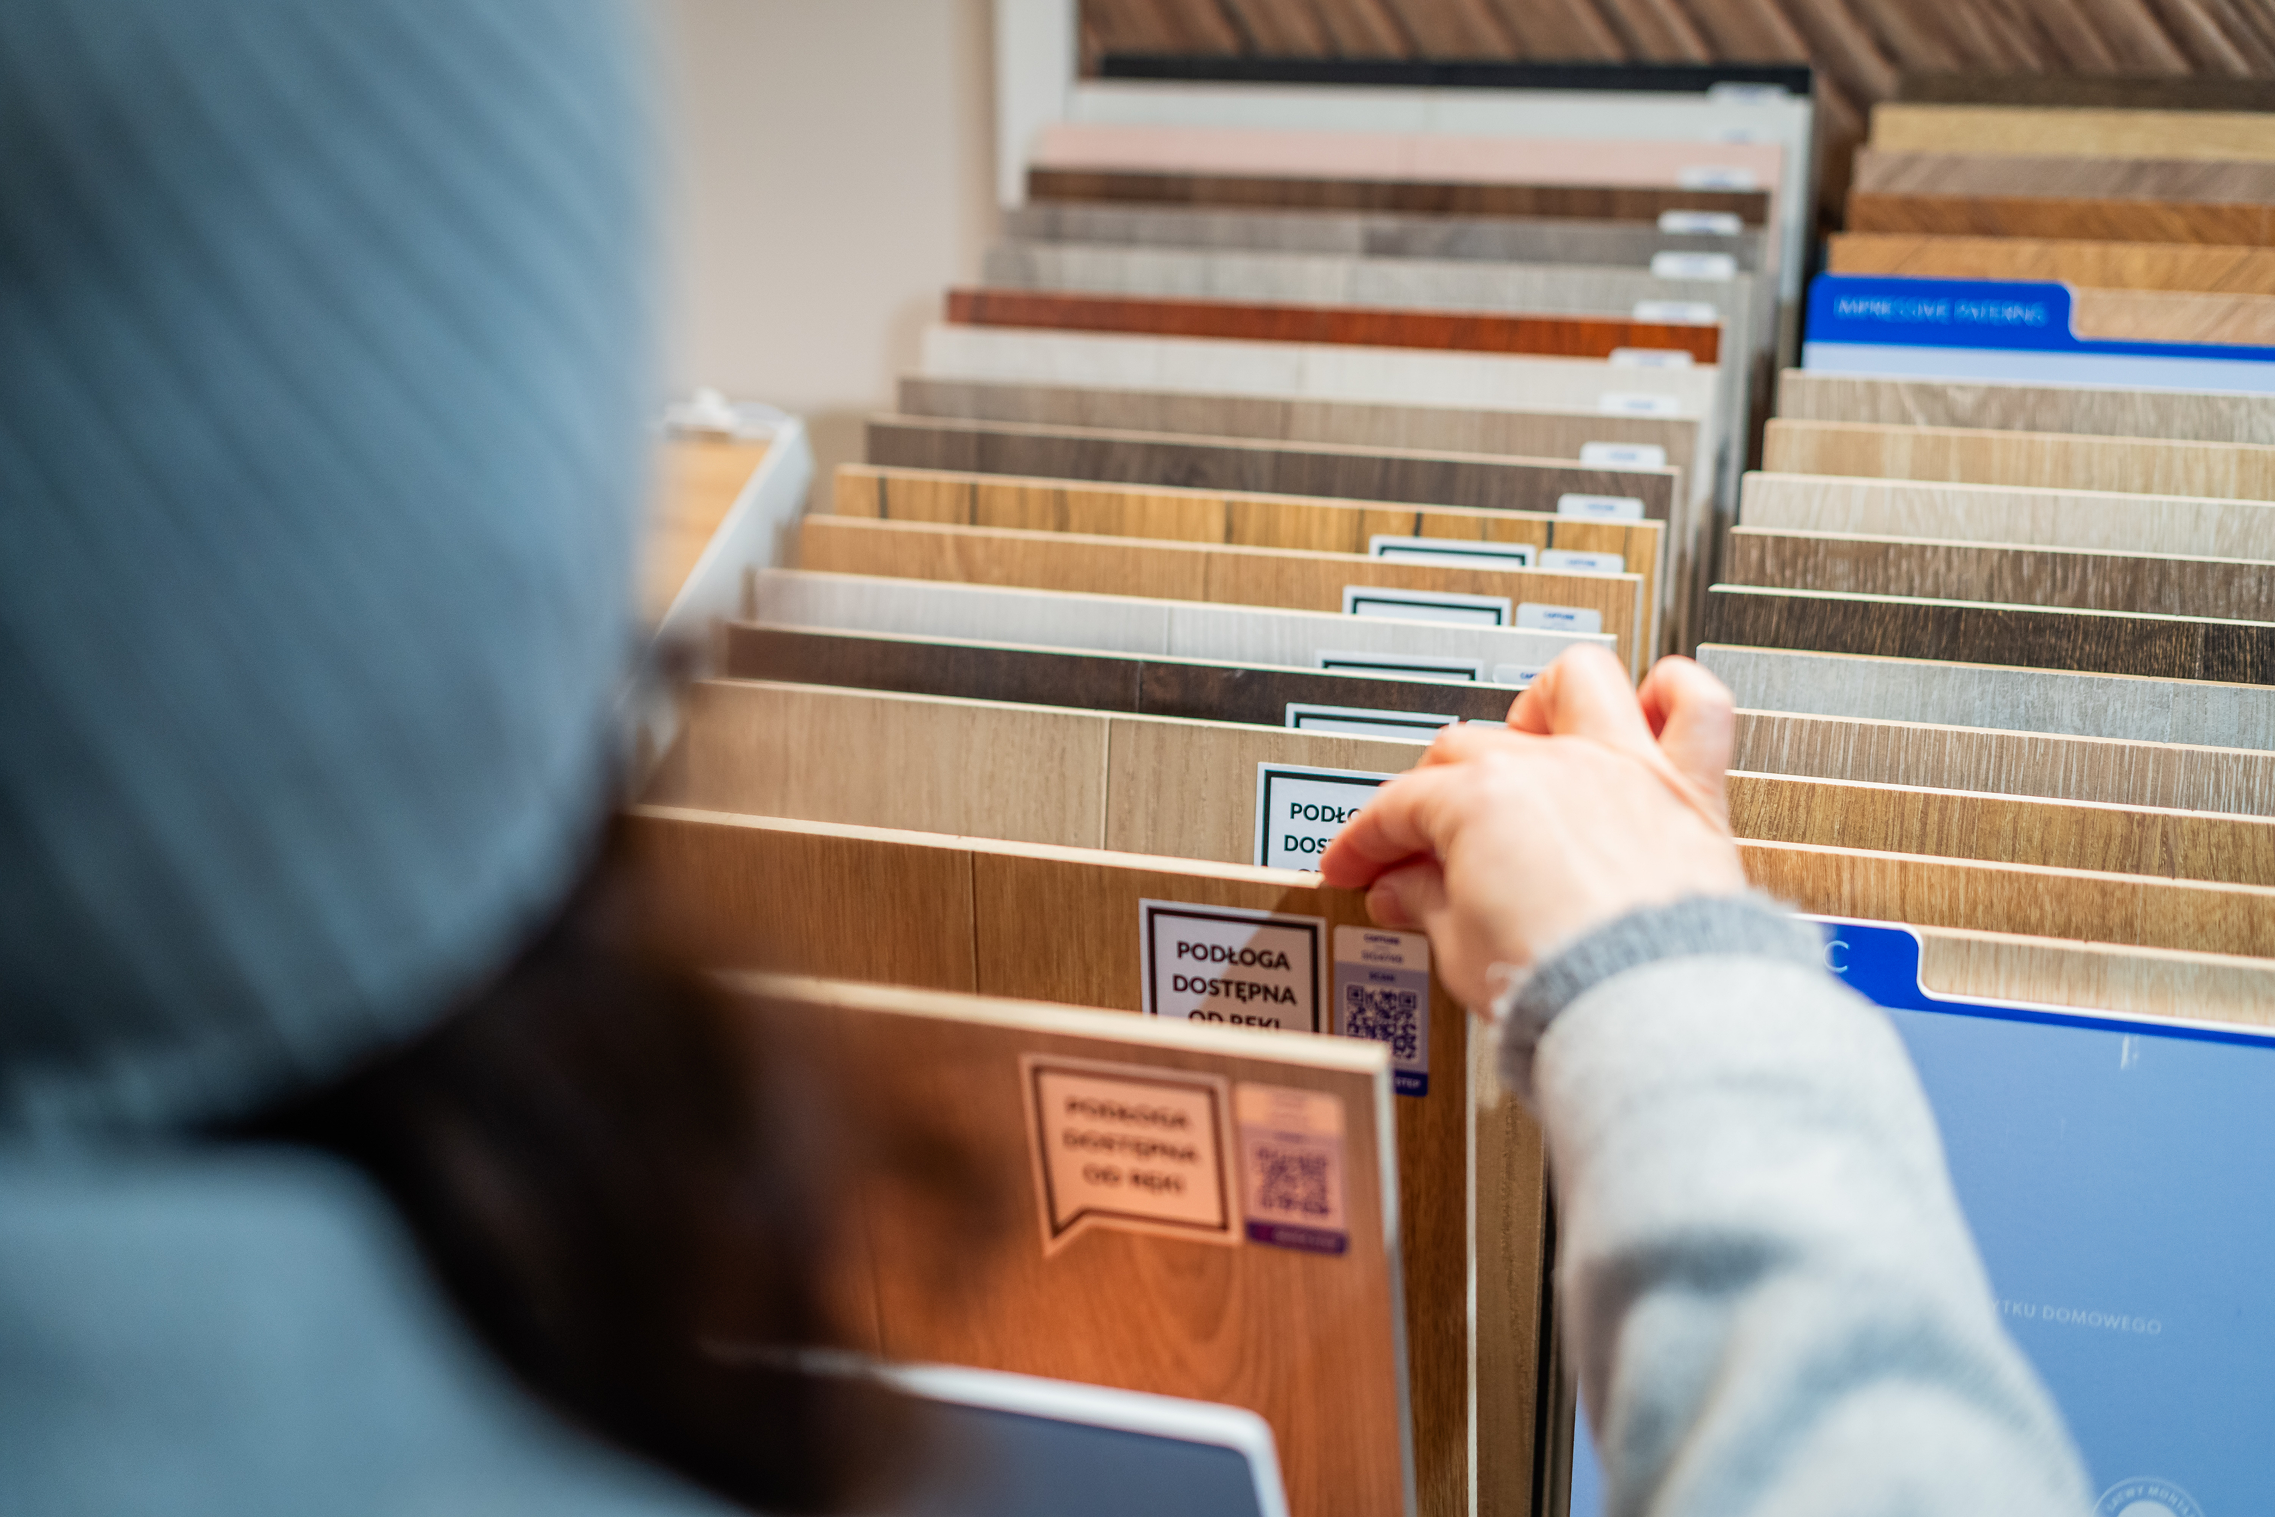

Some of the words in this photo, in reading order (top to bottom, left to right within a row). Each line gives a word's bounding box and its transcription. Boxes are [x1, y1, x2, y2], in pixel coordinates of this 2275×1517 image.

[1177, 940, 1291, 971] PODŁOGA
[1173, 973, 1297, 1006] DOSTĘPNA
[2042, 1304, 2162, 1335] DOMOWEGO
